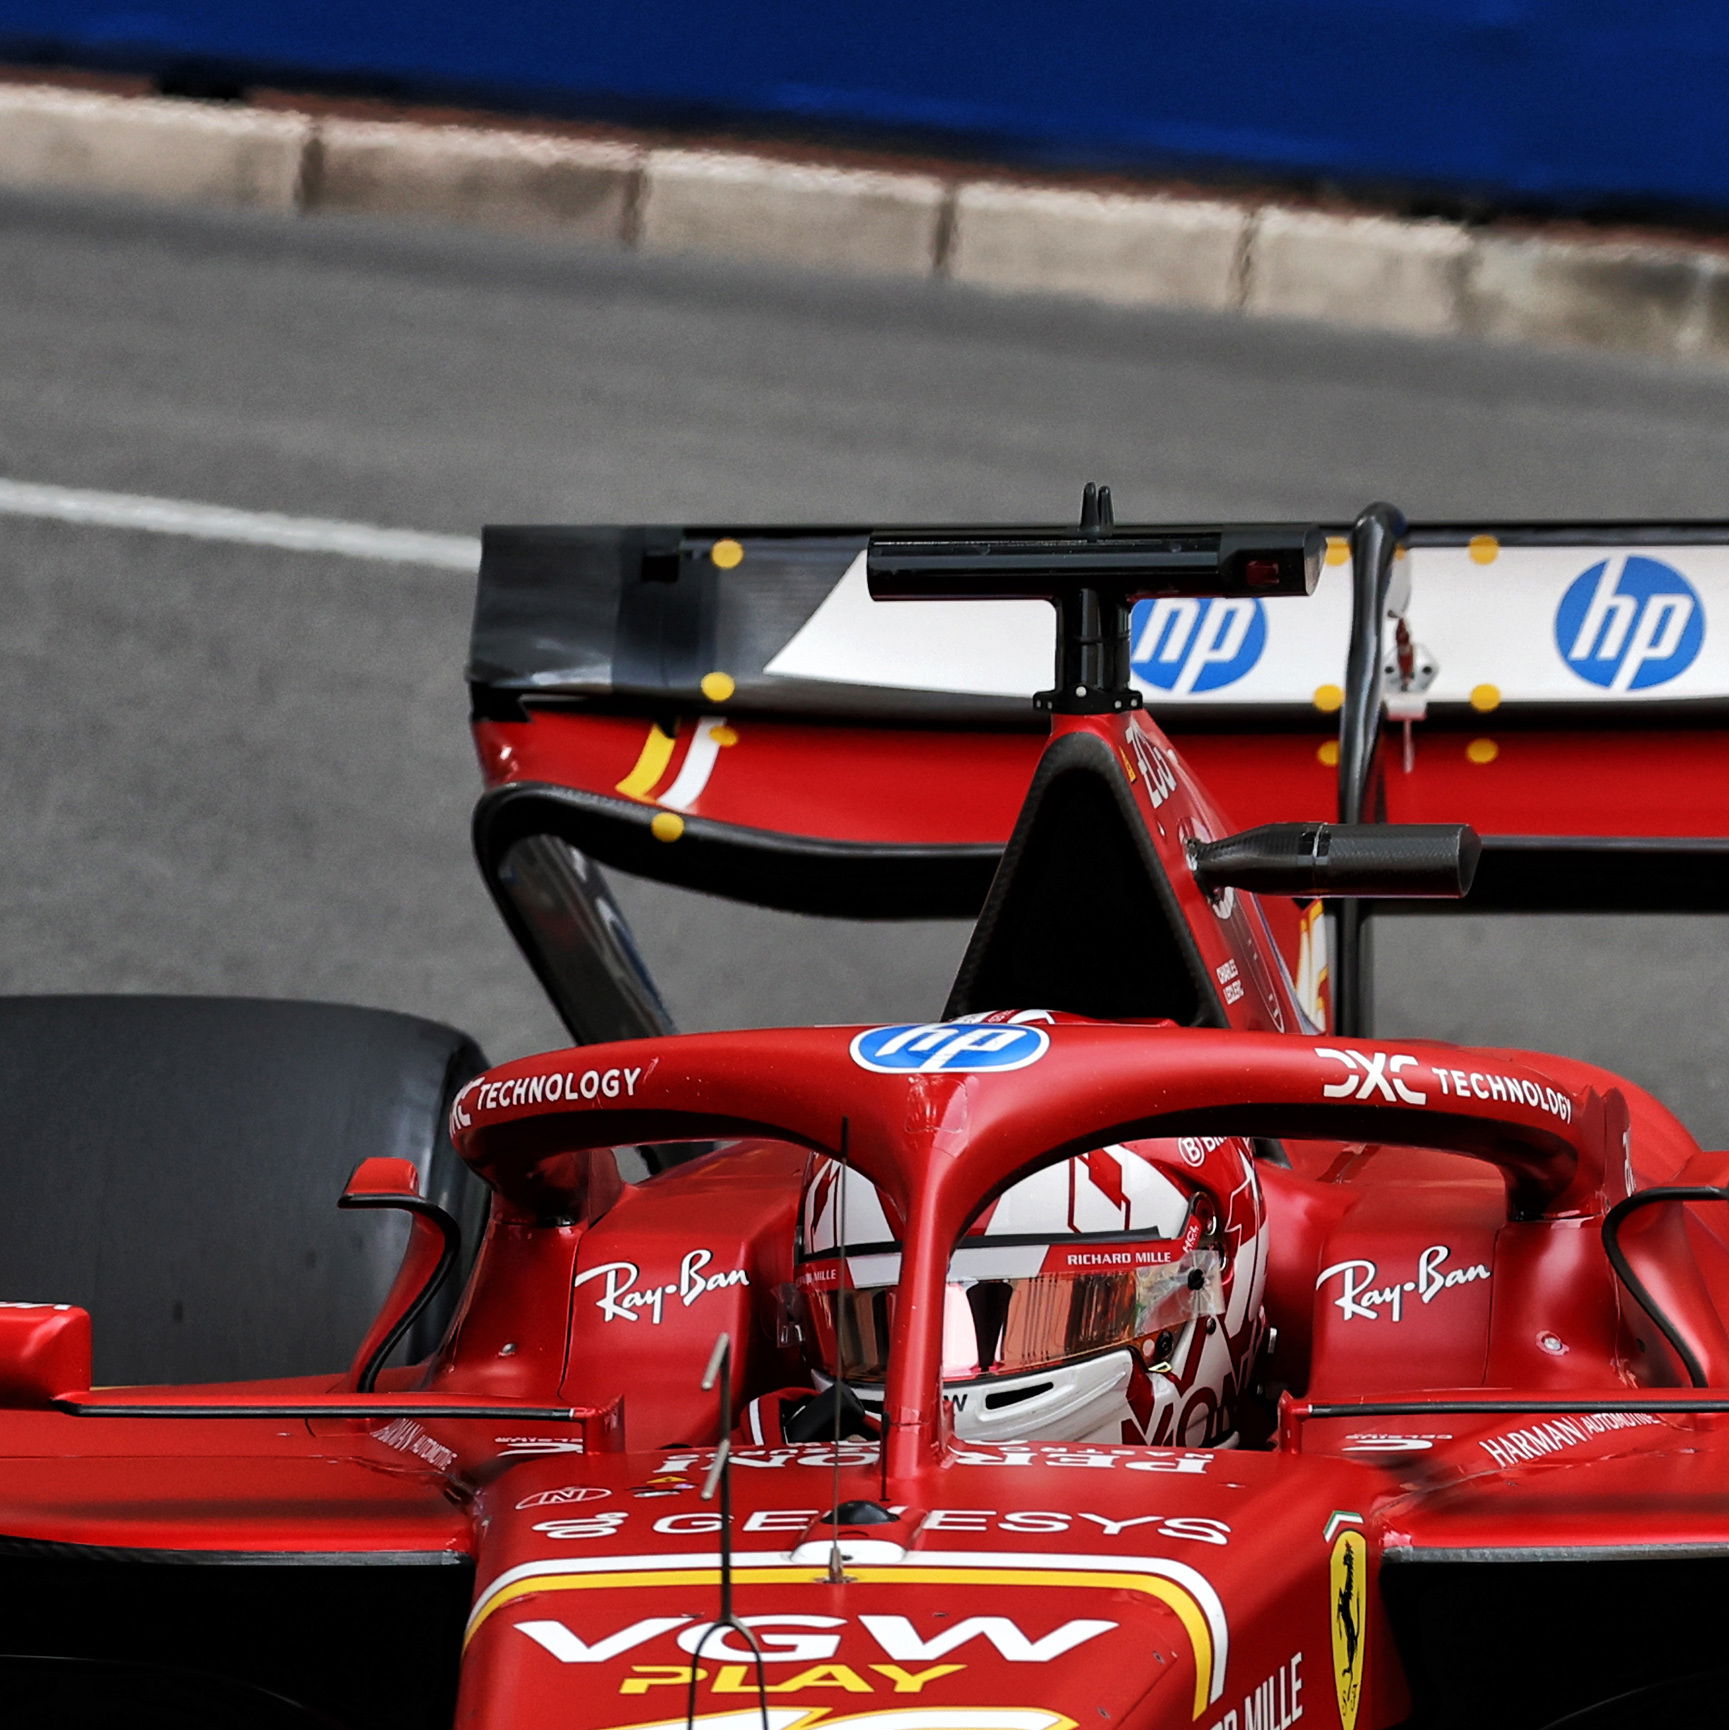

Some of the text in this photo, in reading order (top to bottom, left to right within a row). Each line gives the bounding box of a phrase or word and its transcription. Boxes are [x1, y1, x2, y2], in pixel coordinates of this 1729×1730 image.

[1568, 555, 1695, 692] hp
[475, 1067, 642, 1110] TECHNOLOGY
[1313, 1047, 1573, 1124] DXC TECHNOLOGY
[1067, 1251, 1172, 1266] RICHARD MILLE
[1478, 1415, 1586, 1468] HARMAN
[652, 1509, 1232, 1546] GEESYS
[513, 1613, 1120, 1664] VGW
[618, 1663, 967, 1695] PLAY
